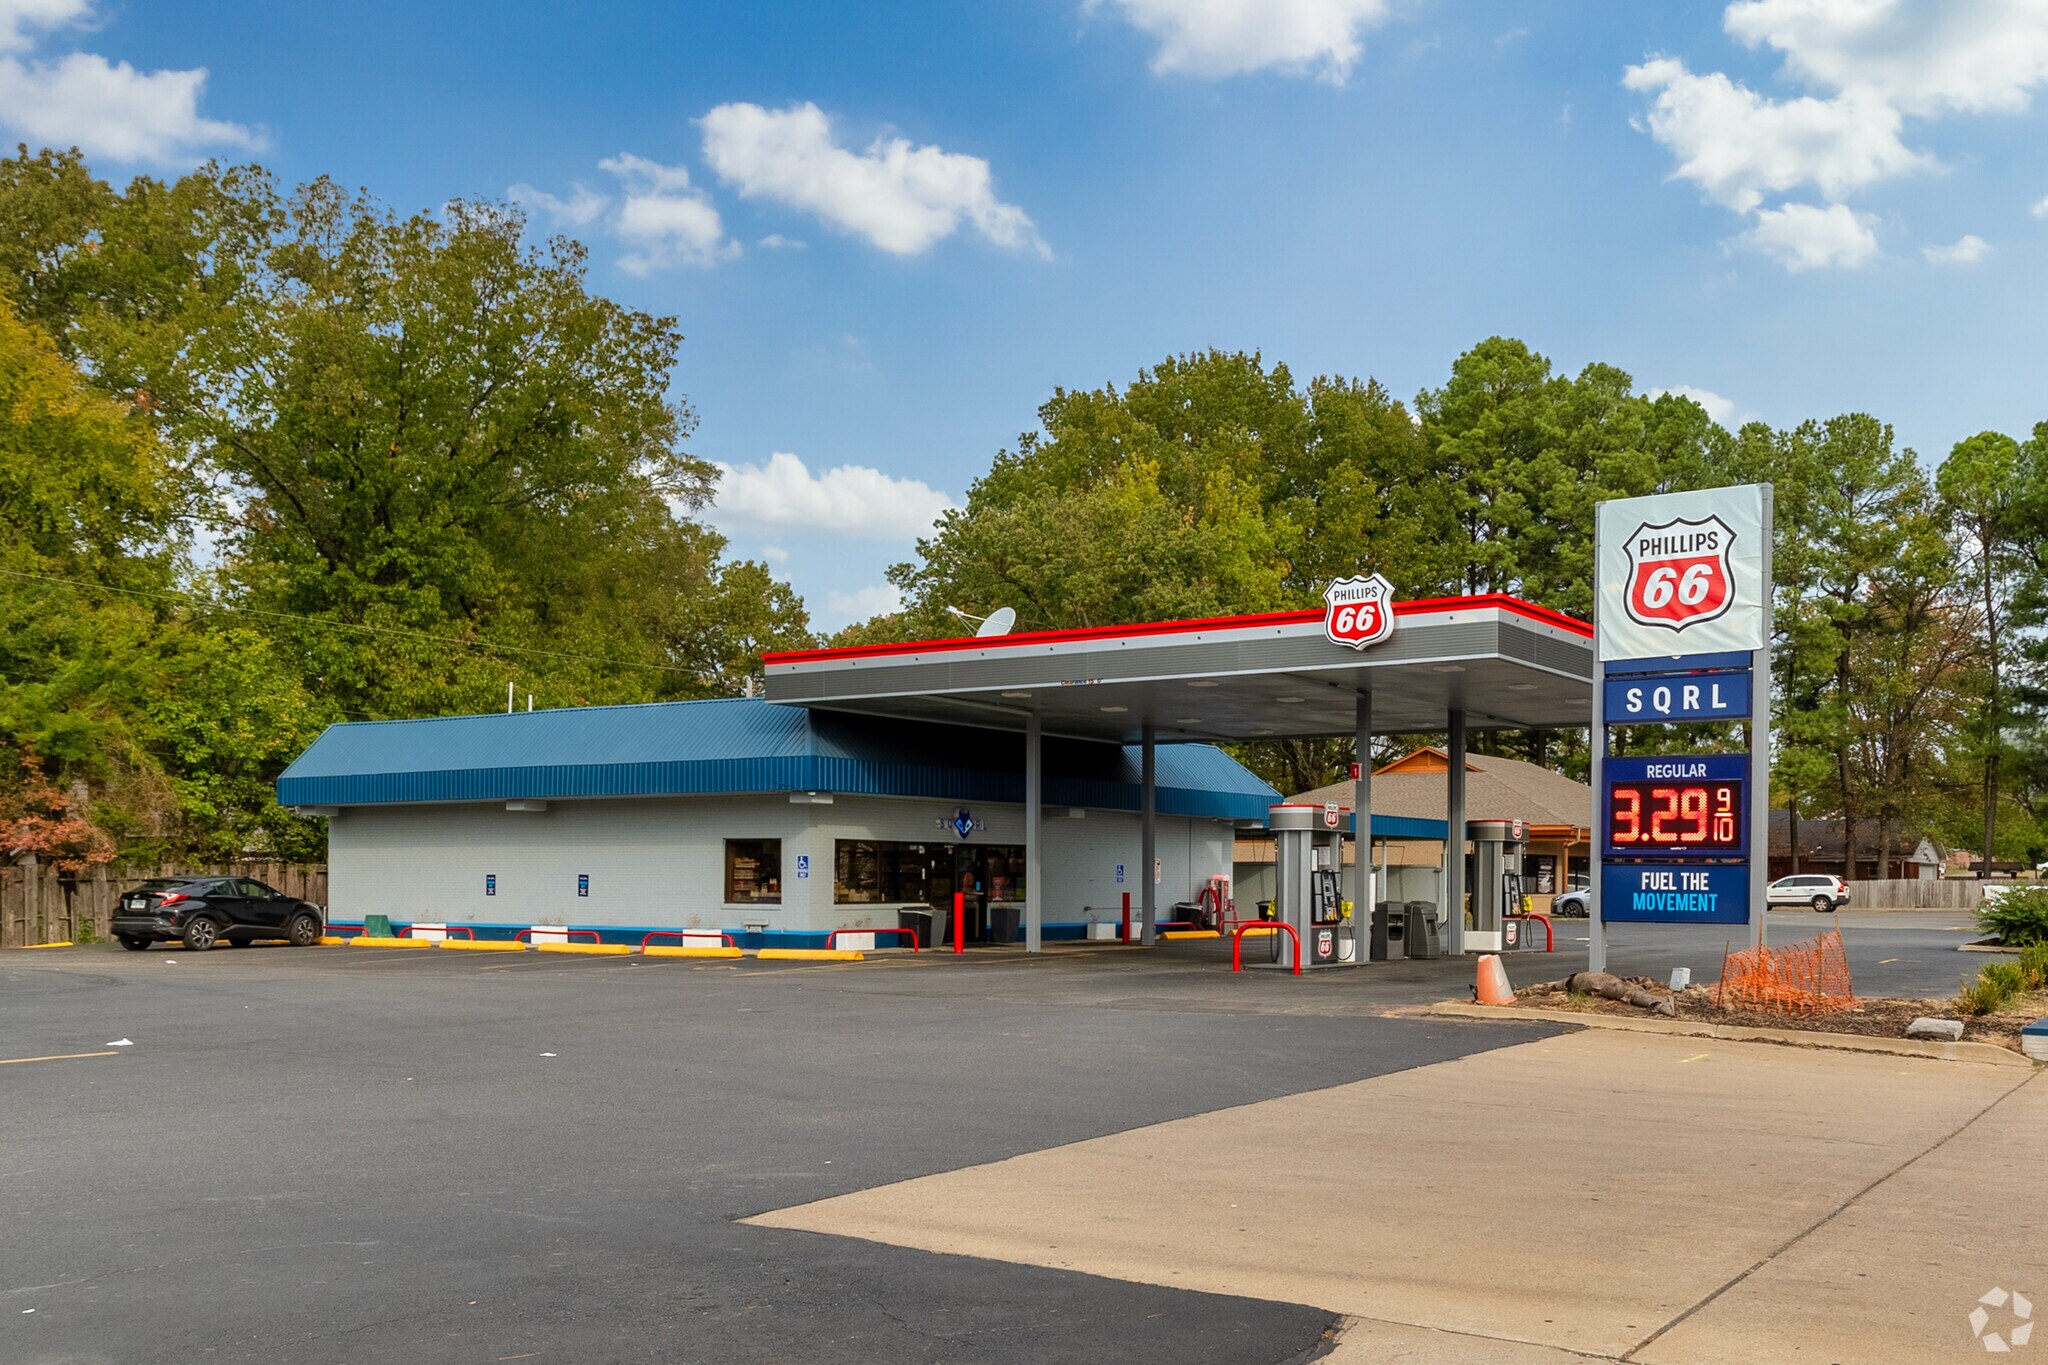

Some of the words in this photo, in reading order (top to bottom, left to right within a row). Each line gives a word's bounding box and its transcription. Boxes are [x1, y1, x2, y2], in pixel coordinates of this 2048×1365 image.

[1639, 531, 1719, 557] PHILLIPS
[1334, 587, 1377, 601] PHILLIPS
[1643, 563, 1713, 609] 66
[1336, 605, 1375, 633] 66
[1647, 763, 1707, 779] REGULAR
[1613, 788, 1708, 842] 3.29
[1641, 872, 1677, 890] FUEL
[1681, 872, 1709, 891] THE
[1633, 893, 1718, 912] MOVEMENT
